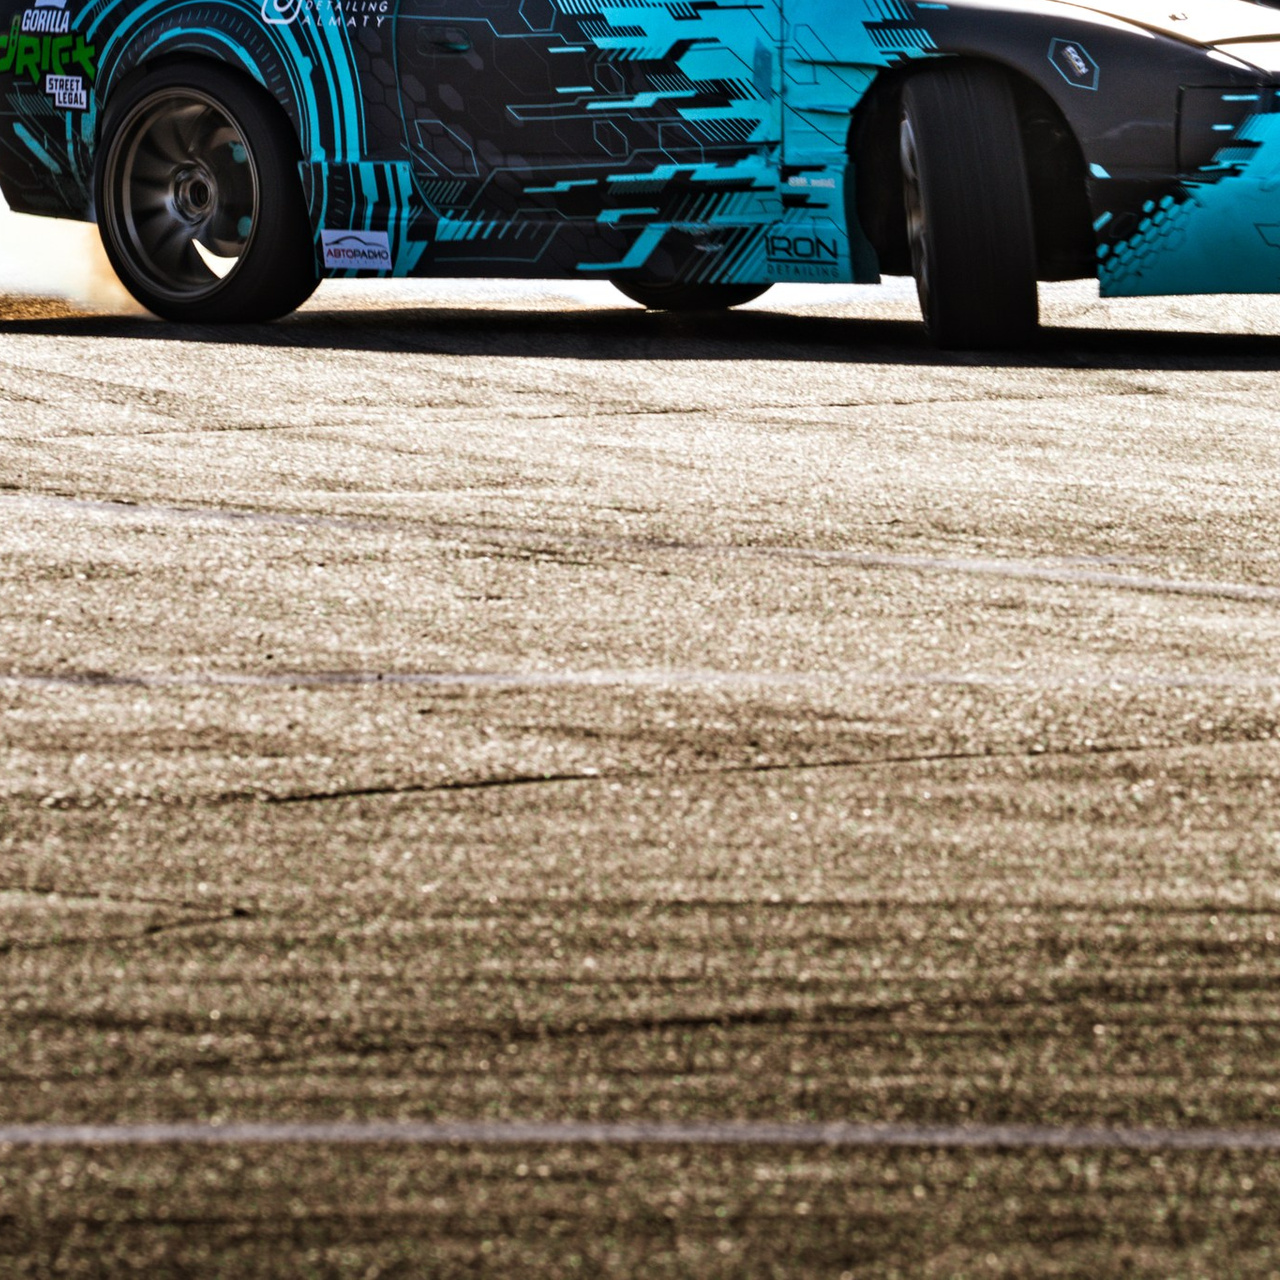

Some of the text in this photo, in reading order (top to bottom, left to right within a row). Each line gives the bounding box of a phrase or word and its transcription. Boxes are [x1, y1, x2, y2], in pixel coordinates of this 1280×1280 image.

[304, 0, 389, 13] DETAILING
[21, 8, 70, 33] GORILLA
[301, 16, 386, 28] ALMATY
[48, 76, 80, 92] STREET
[57, 91, 84, 106] LEGAL
[764, 235, 838, 259] IRON
[767, 264, 841, 278] DETAILING
